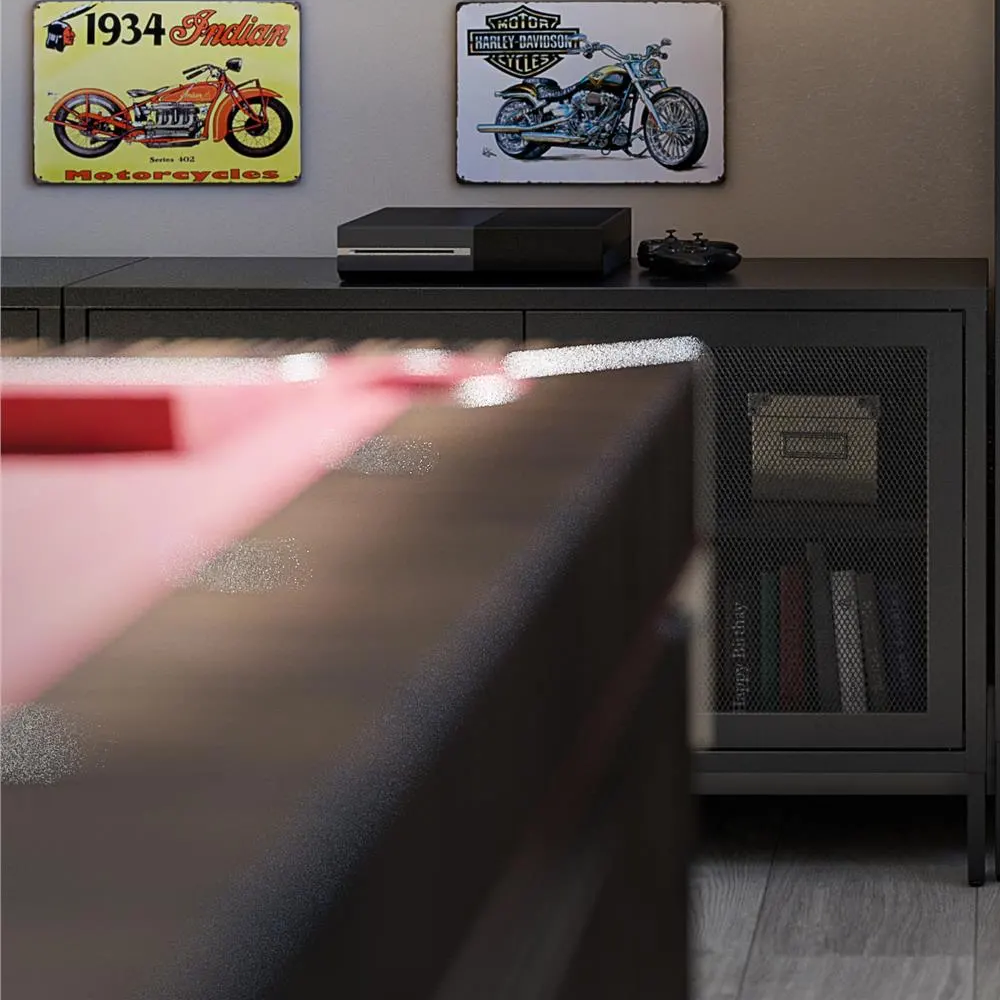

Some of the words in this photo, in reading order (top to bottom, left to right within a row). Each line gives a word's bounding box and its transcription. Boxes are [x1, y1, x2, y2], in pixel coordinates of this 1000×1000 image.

[84, 11, 165, 46] 1934
[169, 9, 291, 47] Indian
[497, 13, 550, 29] MOTOR
[475, 34, 573, 49] HARLEY-DAVIDSON
[496, 54, 551, 73] CYCLES
[65, 168, 280, 183] Motorcycles
